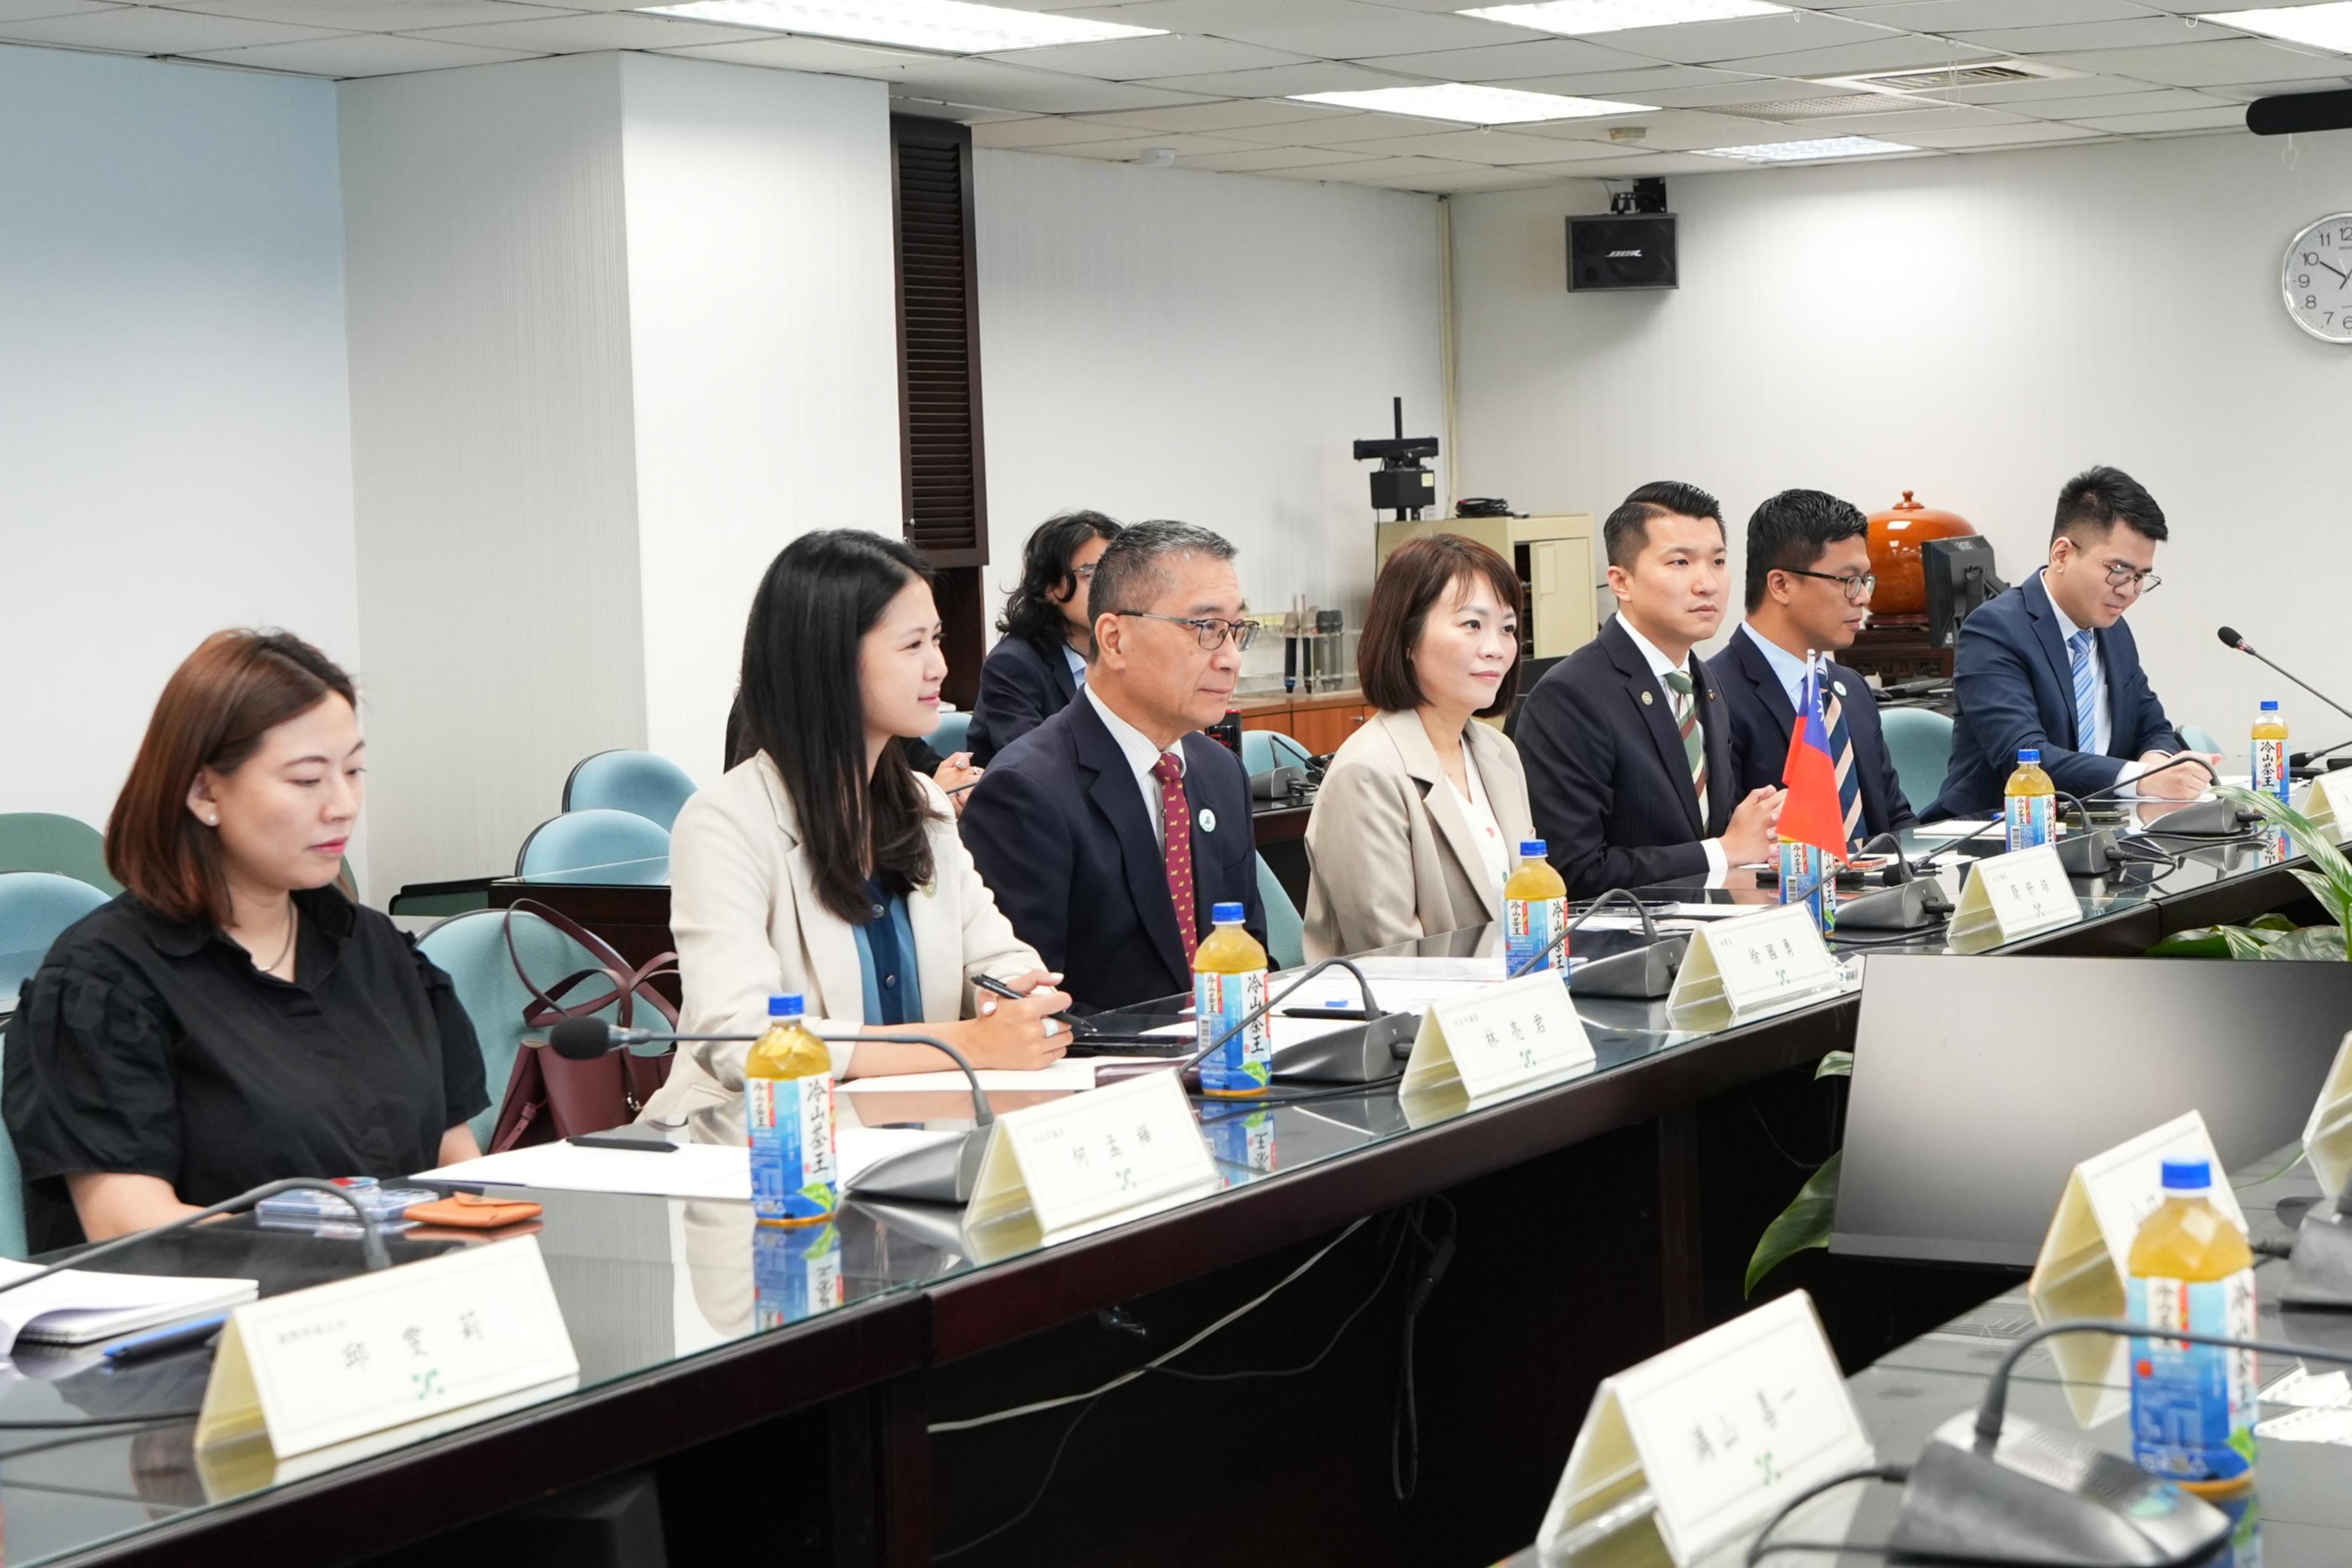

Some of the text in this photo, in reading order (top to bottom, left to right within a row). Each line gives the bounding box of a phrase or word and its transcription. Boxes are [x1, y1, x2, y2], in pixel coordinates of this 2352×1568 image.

[2320, 233, 2330, 247] 11
[2340, 227, 2352, 241] 12
[2303, 252, 2318, 266] 10
[2298, 274, 2310, 288] 9
[2305, 295, 2316, 309] 8
[2323, 311, 2334, 324] 7
[2343, 316, 2352, 329] 6
[2260, 741, 2275, 787] 冷山茶王
[807, 1078, 828, 1174] 冷山茶王
